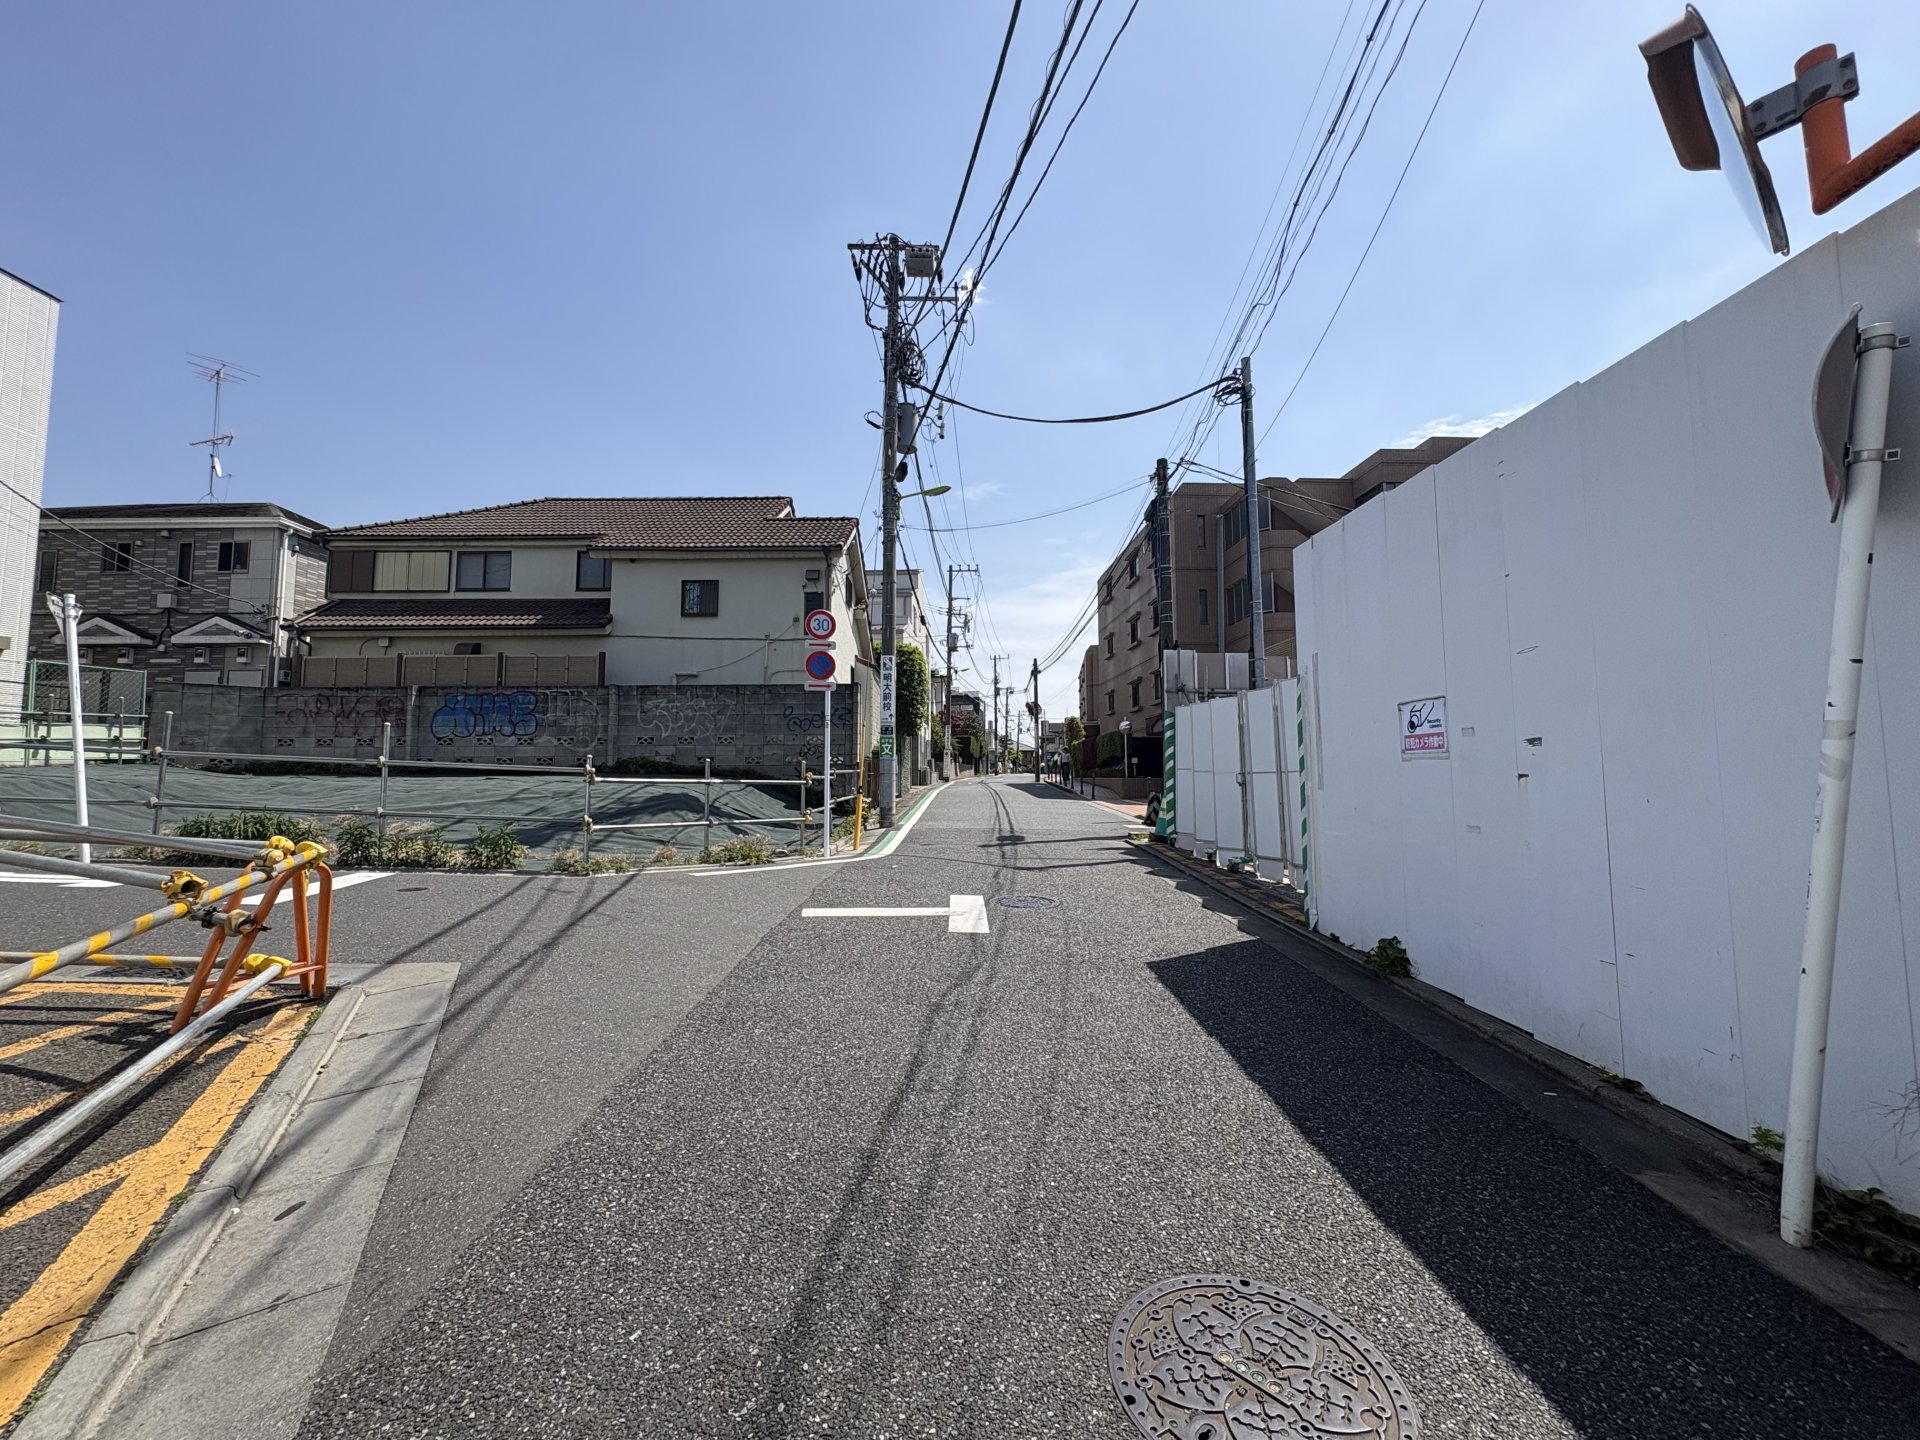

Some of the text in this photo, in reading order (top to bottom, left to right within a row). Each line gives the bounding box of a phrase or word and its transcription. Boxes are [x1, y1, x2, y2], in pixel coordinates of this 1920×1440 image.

[813, 618, 830, 631] 30
[883, 673, 893, 711] 明大前校
[881, 742, 892, 755] 文
